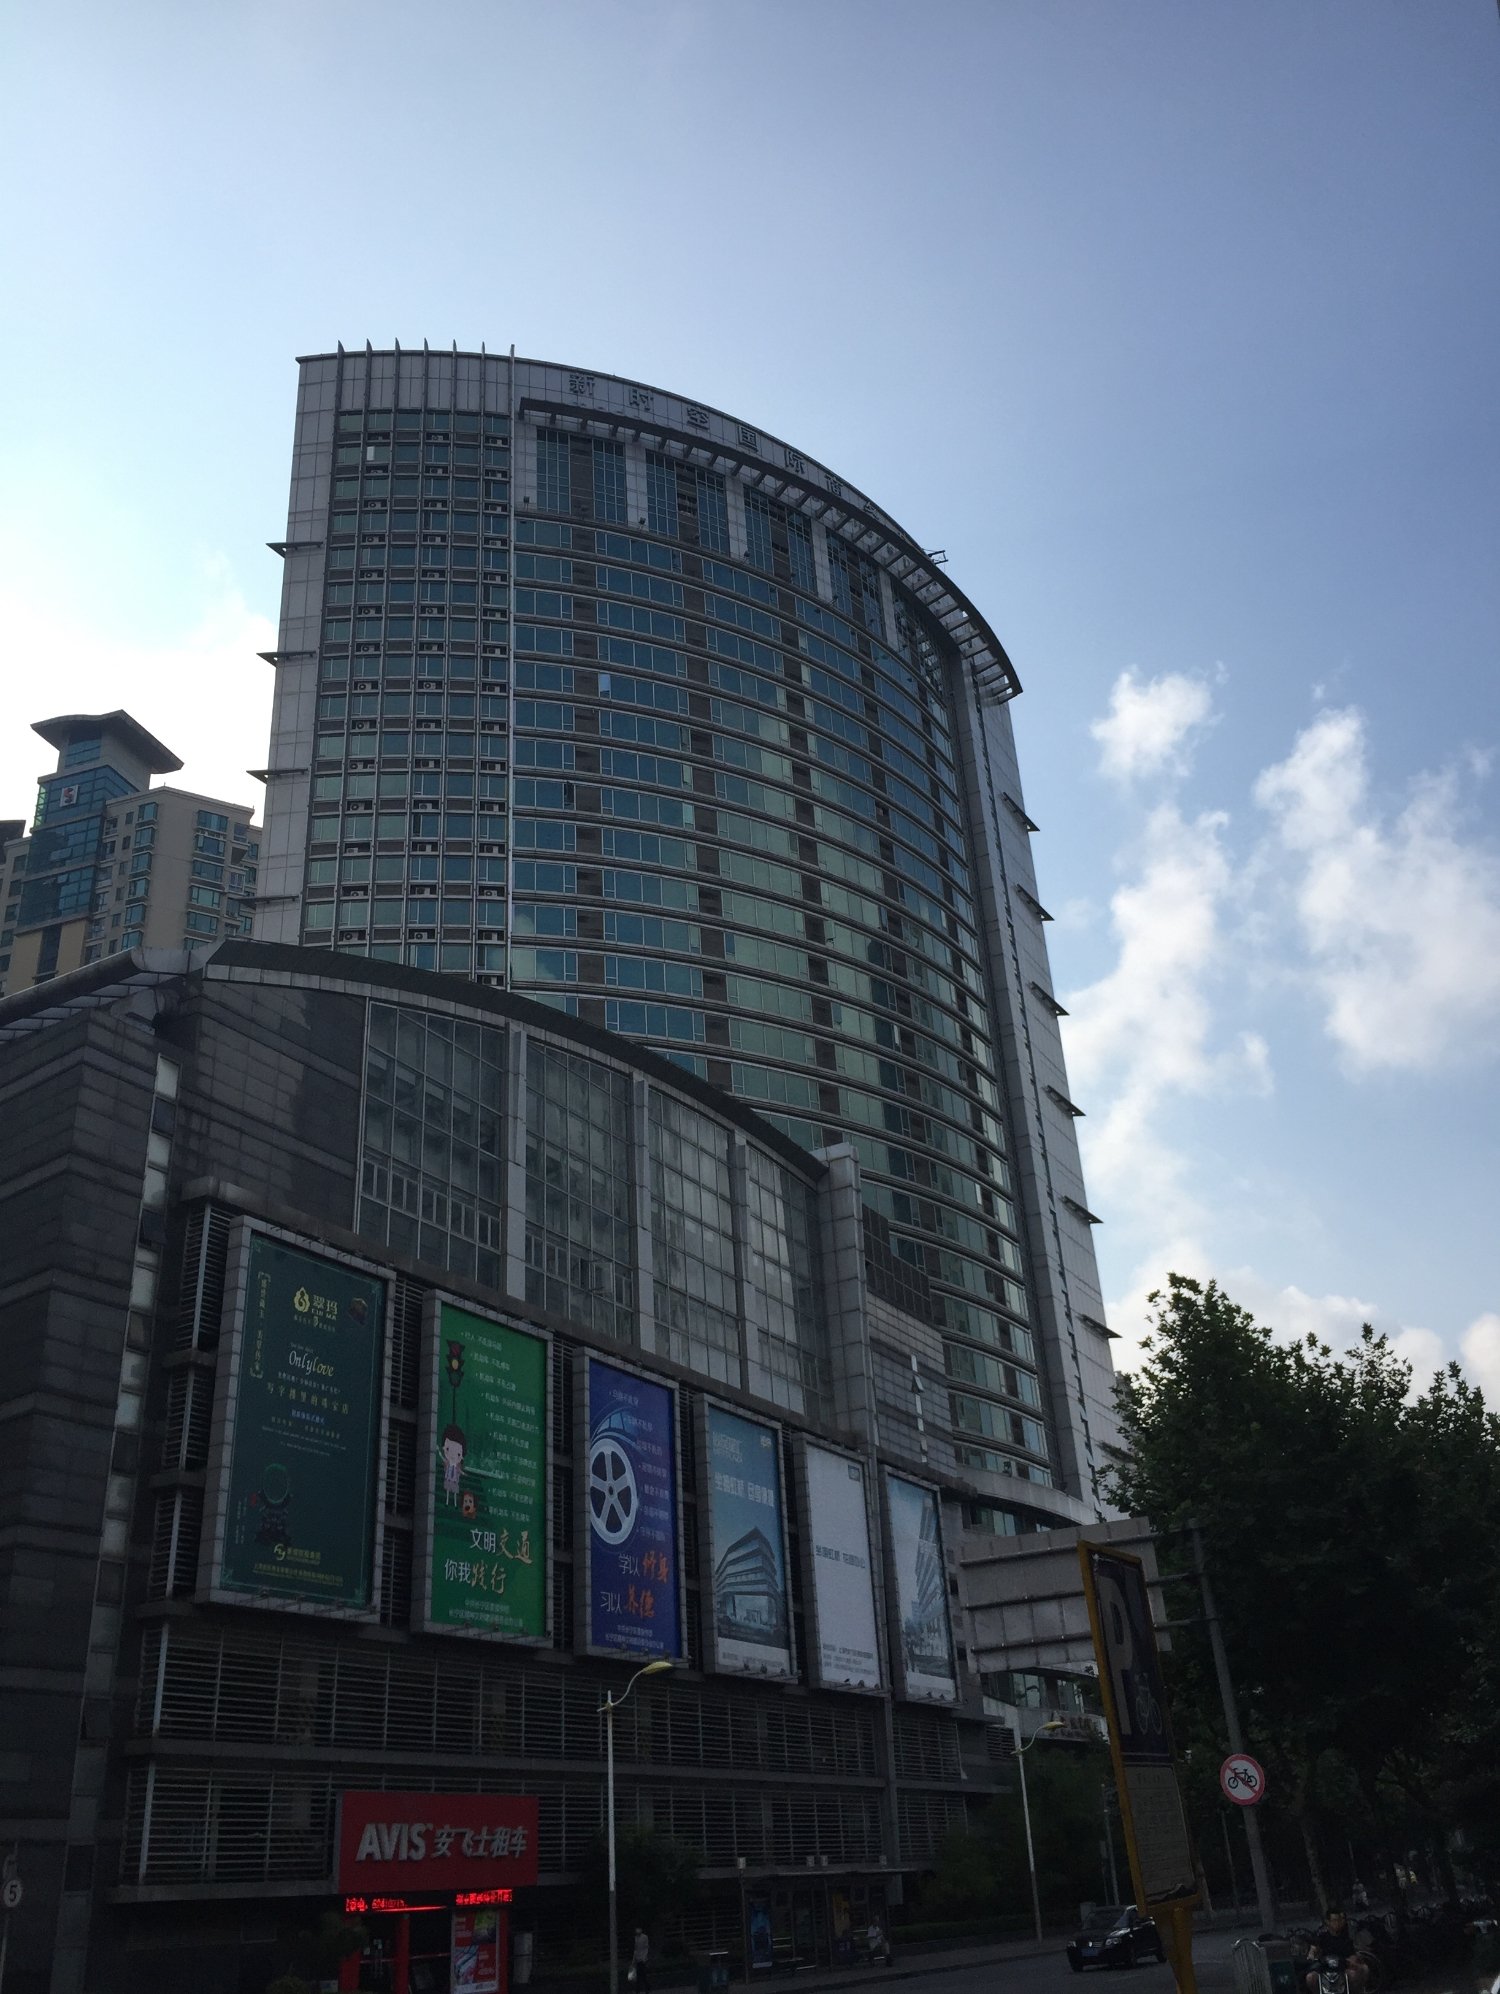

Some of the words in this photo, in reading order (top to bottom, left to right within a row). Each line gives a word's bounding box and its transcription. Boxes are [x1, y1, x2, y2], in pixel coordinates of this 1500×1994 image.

[470, 1527, 534, 1565] 文明交通
[445, 1558, 507, 1595] 你我践行
[355, 1822, 428, 1862] AVIS
[431, 1823, 529, 1859] 安飞士租车
[9, 1884, 18, 1903] 5
